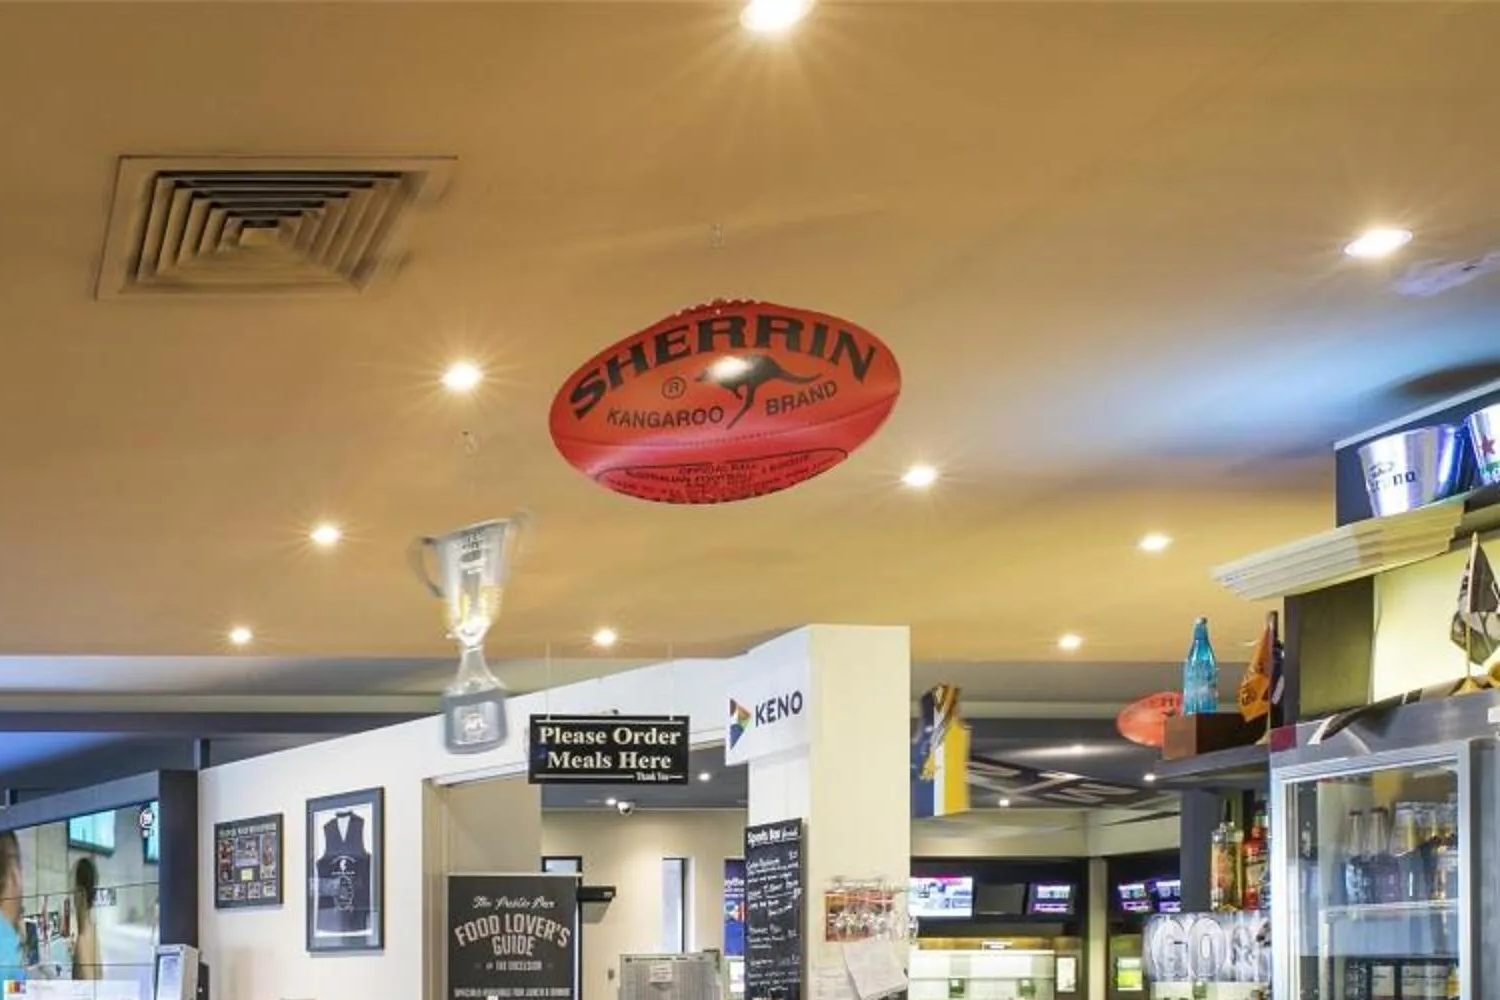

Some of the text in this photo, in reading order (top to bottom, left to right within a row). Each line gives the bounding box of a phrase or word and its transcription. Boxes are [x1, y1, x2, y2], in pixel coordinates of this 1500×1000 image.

[569, 313, 878, 420] SHERRIN
[605, 380, 839, 430] KANGAROO BRAND
[755, 689, 804, 727] KENO
[539, 726, 681, 745] Please Order
[547, 751, 672, 769] Meals Here
[453, 913, 571, 948] FOOD LOVER'S
[491, 934, 536, 956] GUIDE
